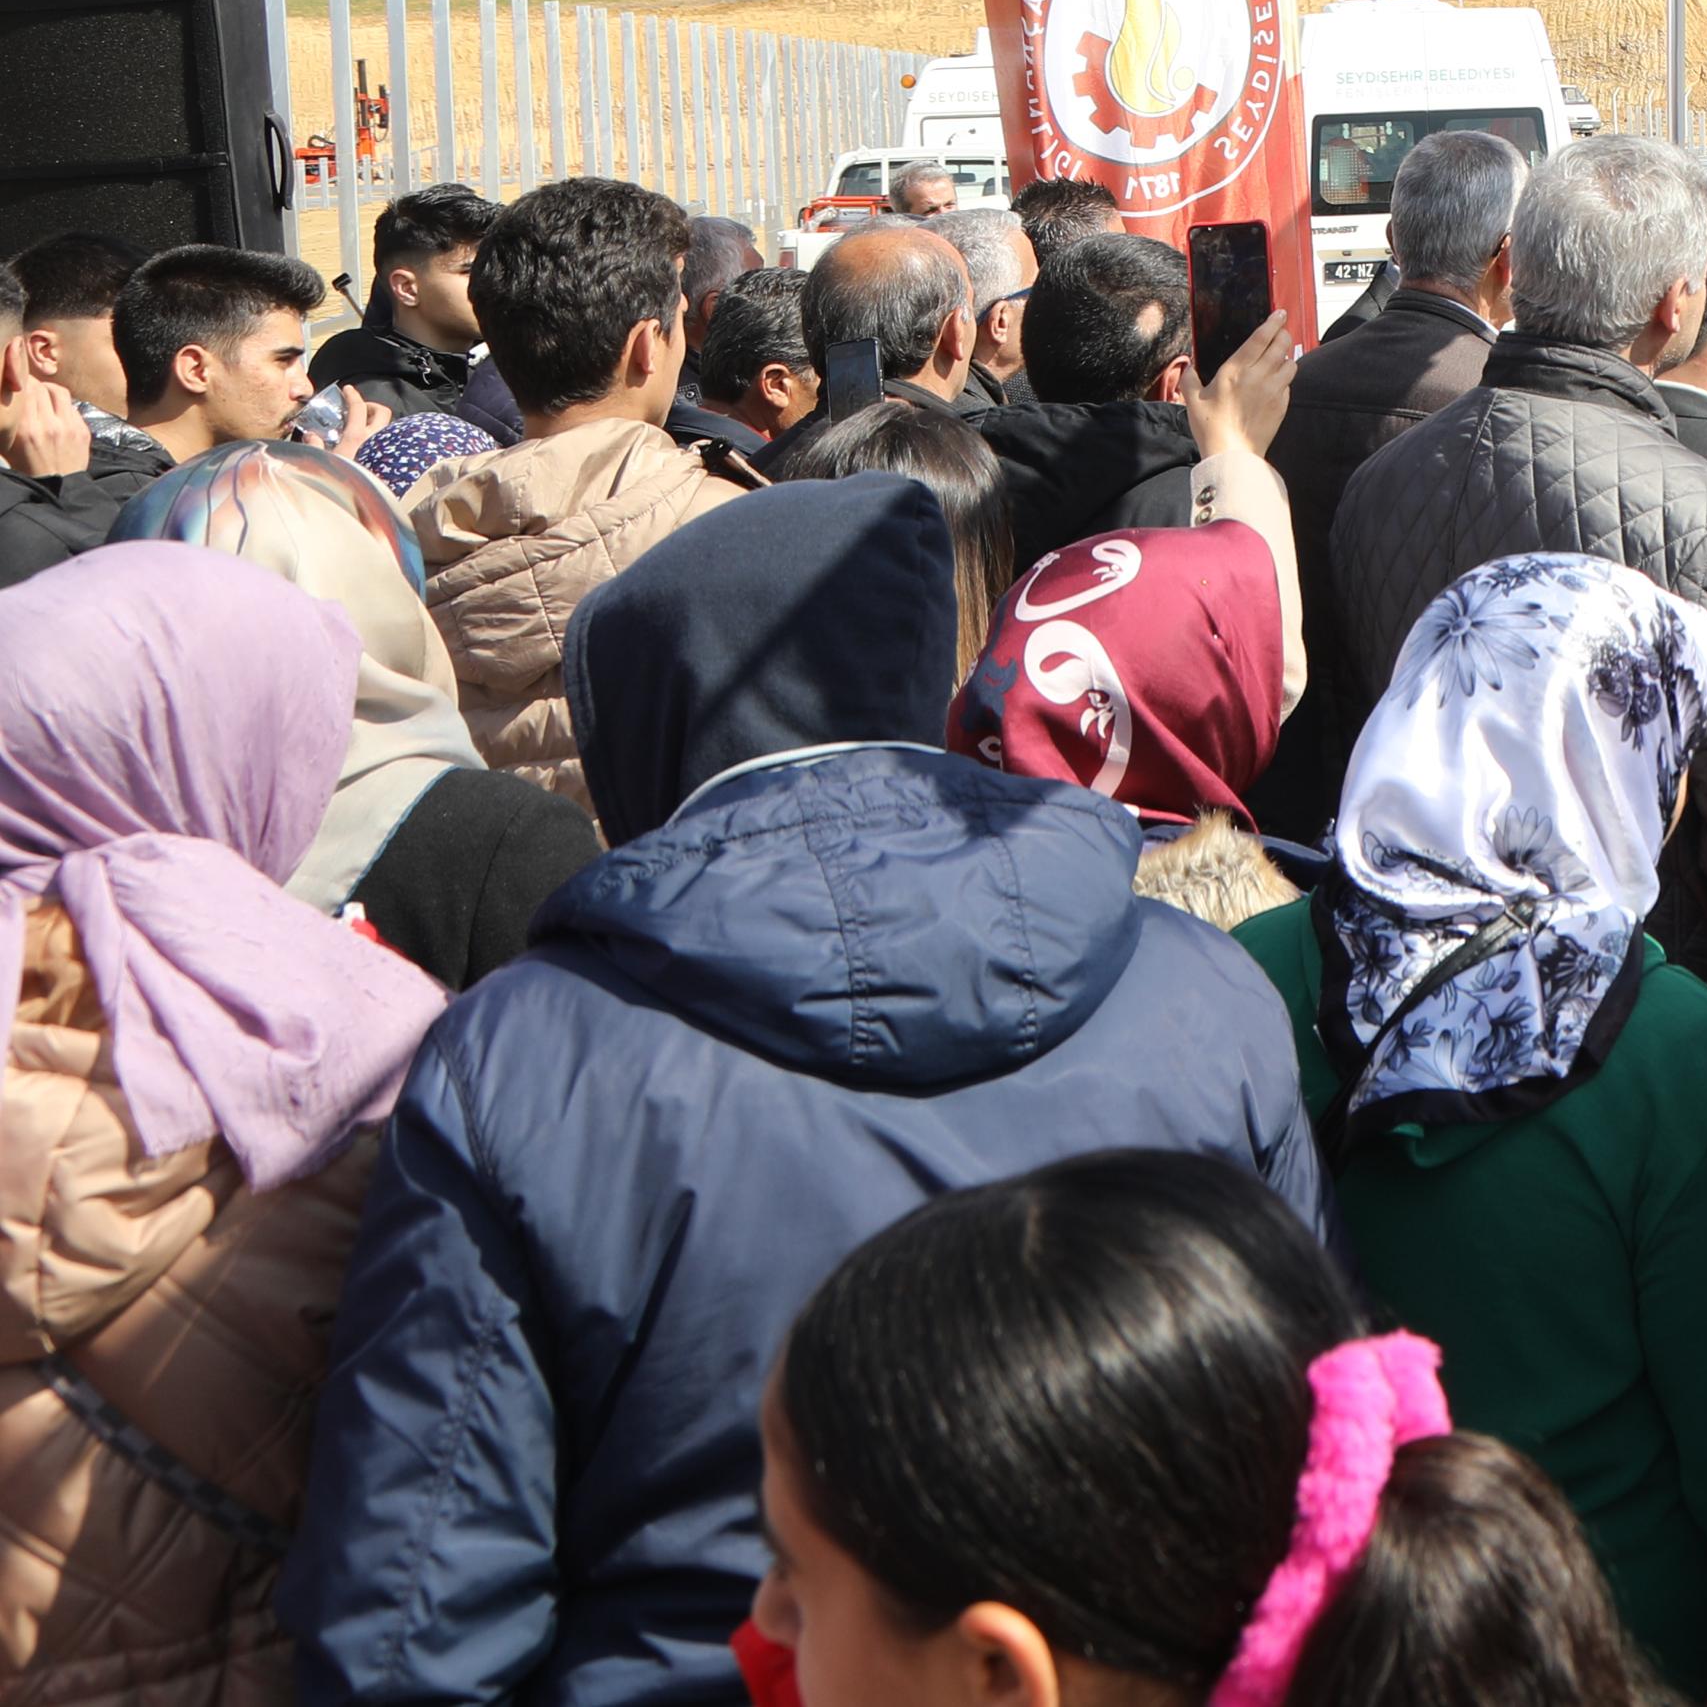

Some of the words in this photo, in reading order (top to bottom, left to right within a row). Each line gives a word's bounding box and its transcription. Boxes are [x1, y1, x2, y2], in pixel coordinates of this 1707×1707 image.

[1335, 69, 1424, 84] SEYDİŞEHİR
[1428, 67, 1515, 82] BELEDİYESİ
[1335, 264, 1351, 279] 42
